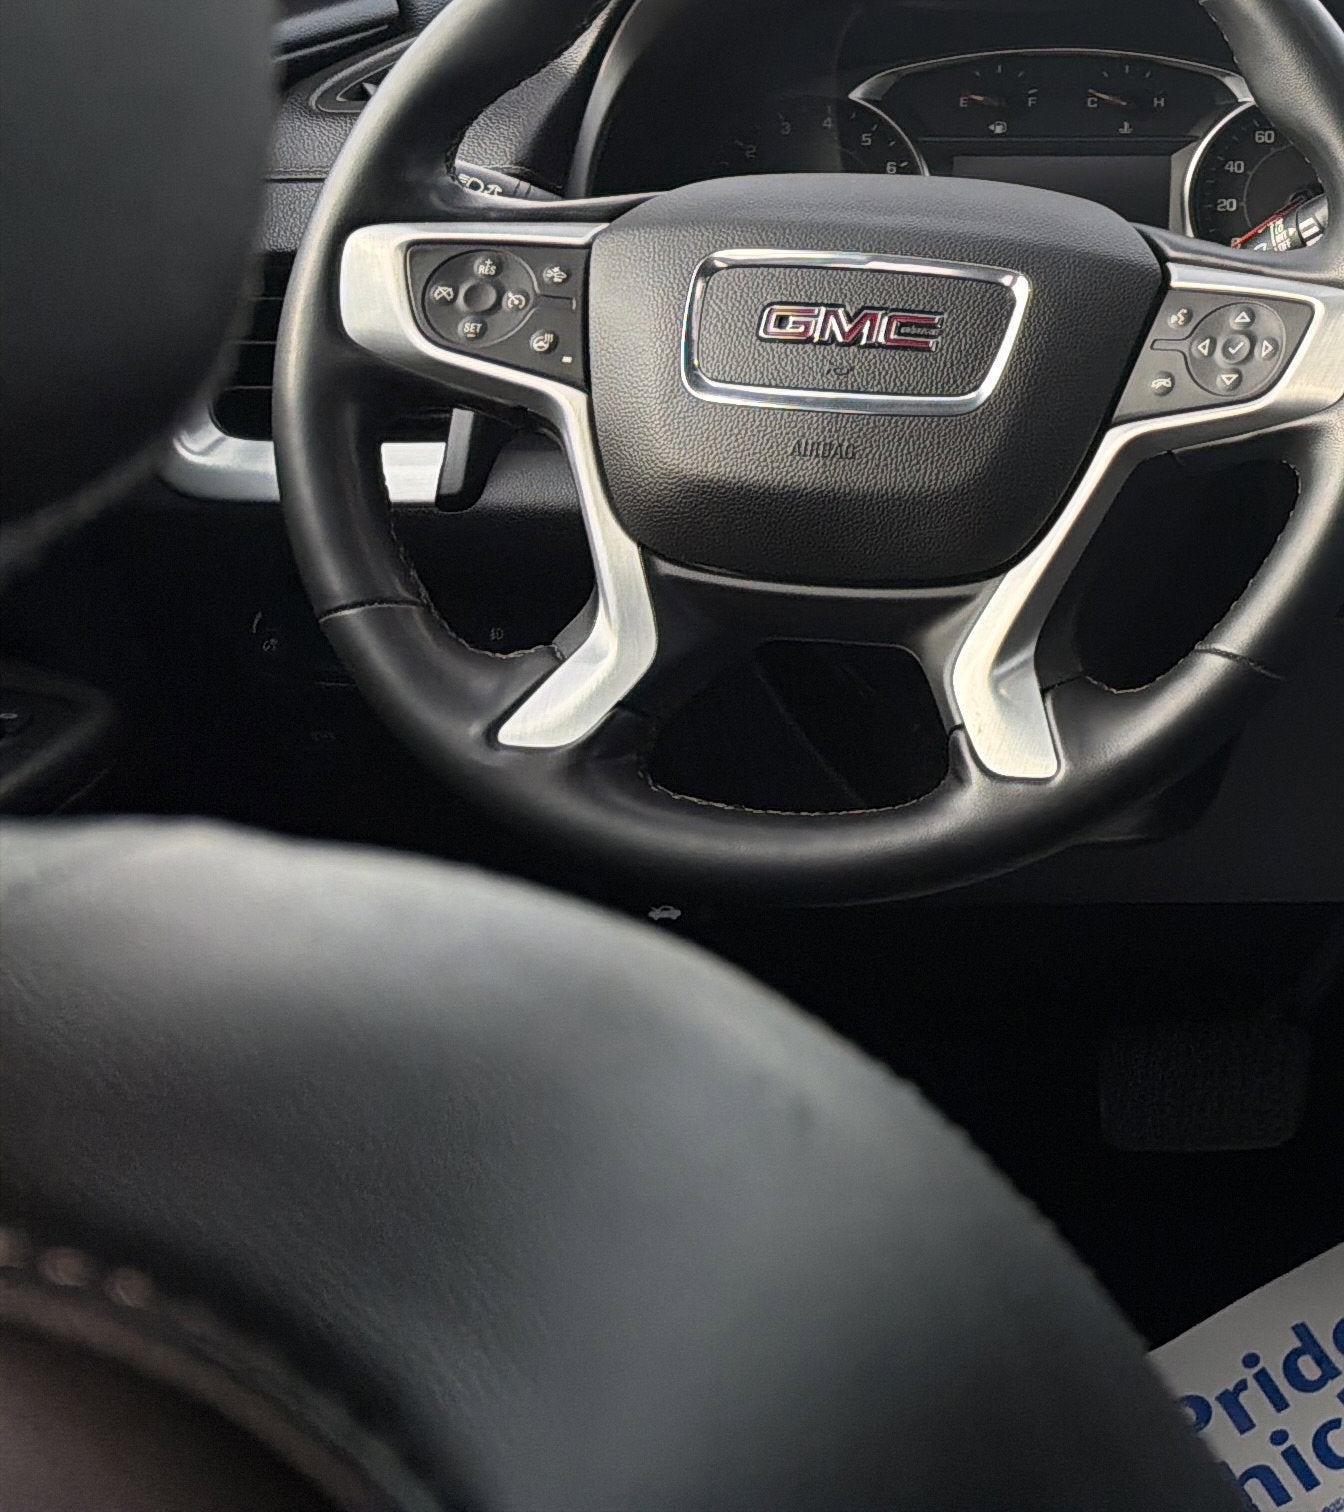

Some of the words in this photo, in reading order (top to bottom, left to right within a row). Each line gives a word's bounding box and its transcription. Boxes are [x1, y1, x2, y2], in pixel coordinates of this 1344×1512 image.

[1028, 97, 1038, 108] F
[1087, 96, 1099, 108] C
[1153, 97, 1166, 108] H
[860, 133, 872, 146] 5
[1254, 130, 1276, 144] 60
[886, 161, 897, 174] 6
[1224, 160, 1245, 174] 40
[1216, 198, 1238, 212] 20
[478, 265, 497, 276] RES
[463, 323, 483, 334] SET
[758, 301, 944, 352] GMC
